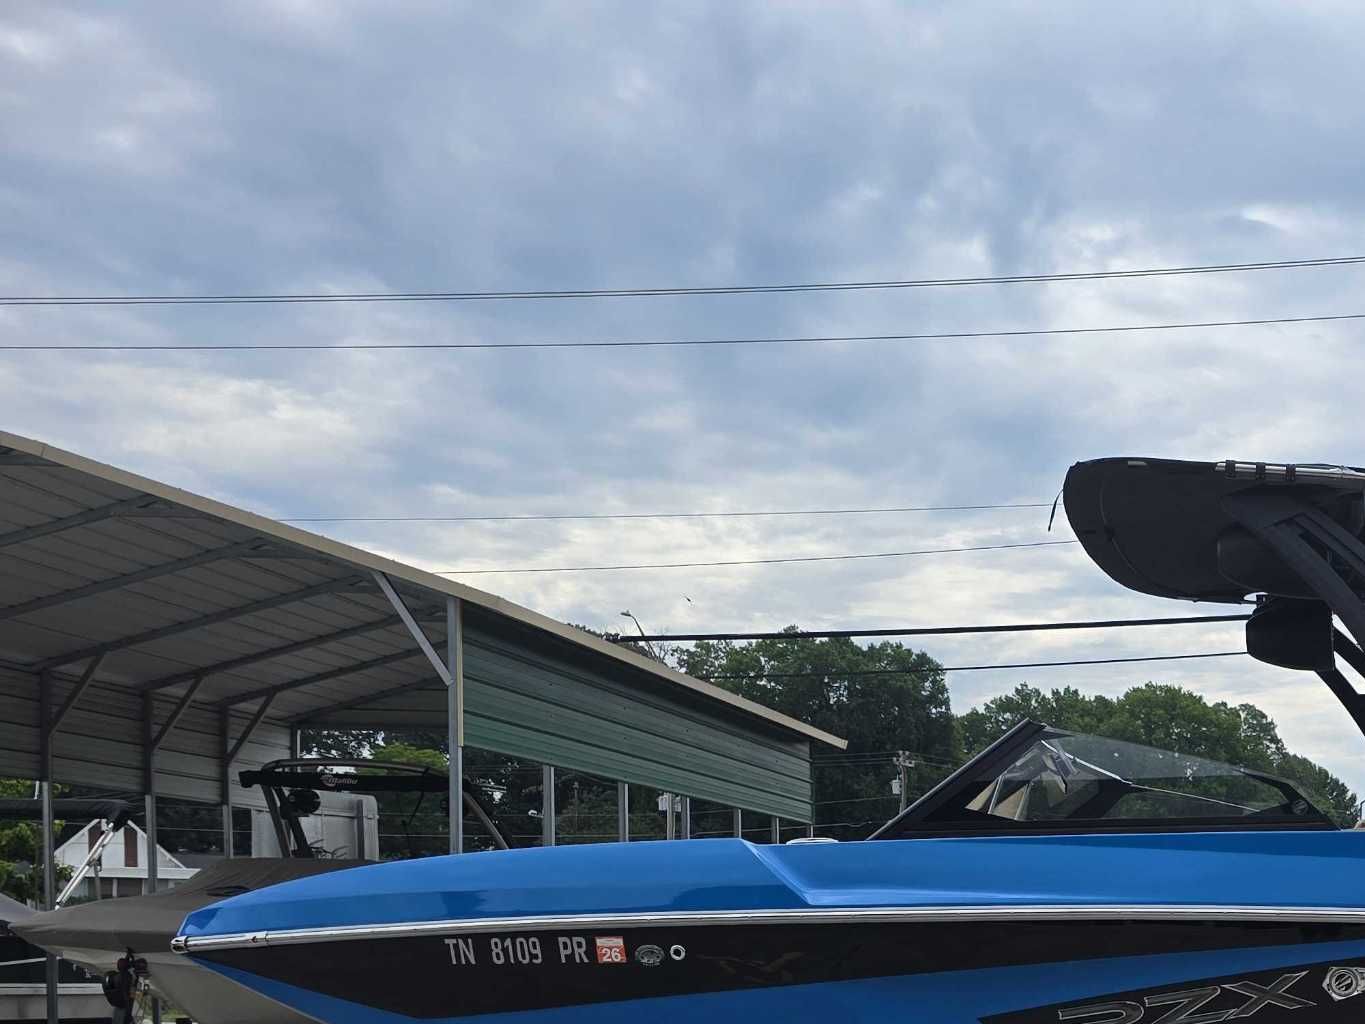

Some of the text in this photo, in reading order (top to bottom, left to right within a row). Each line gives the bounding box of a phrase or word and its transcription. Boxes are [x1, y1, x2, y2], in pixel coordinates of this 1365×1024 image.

[445, 936, 589, 965] TN 8109 PR
[602, 947, 621, 962] 26
